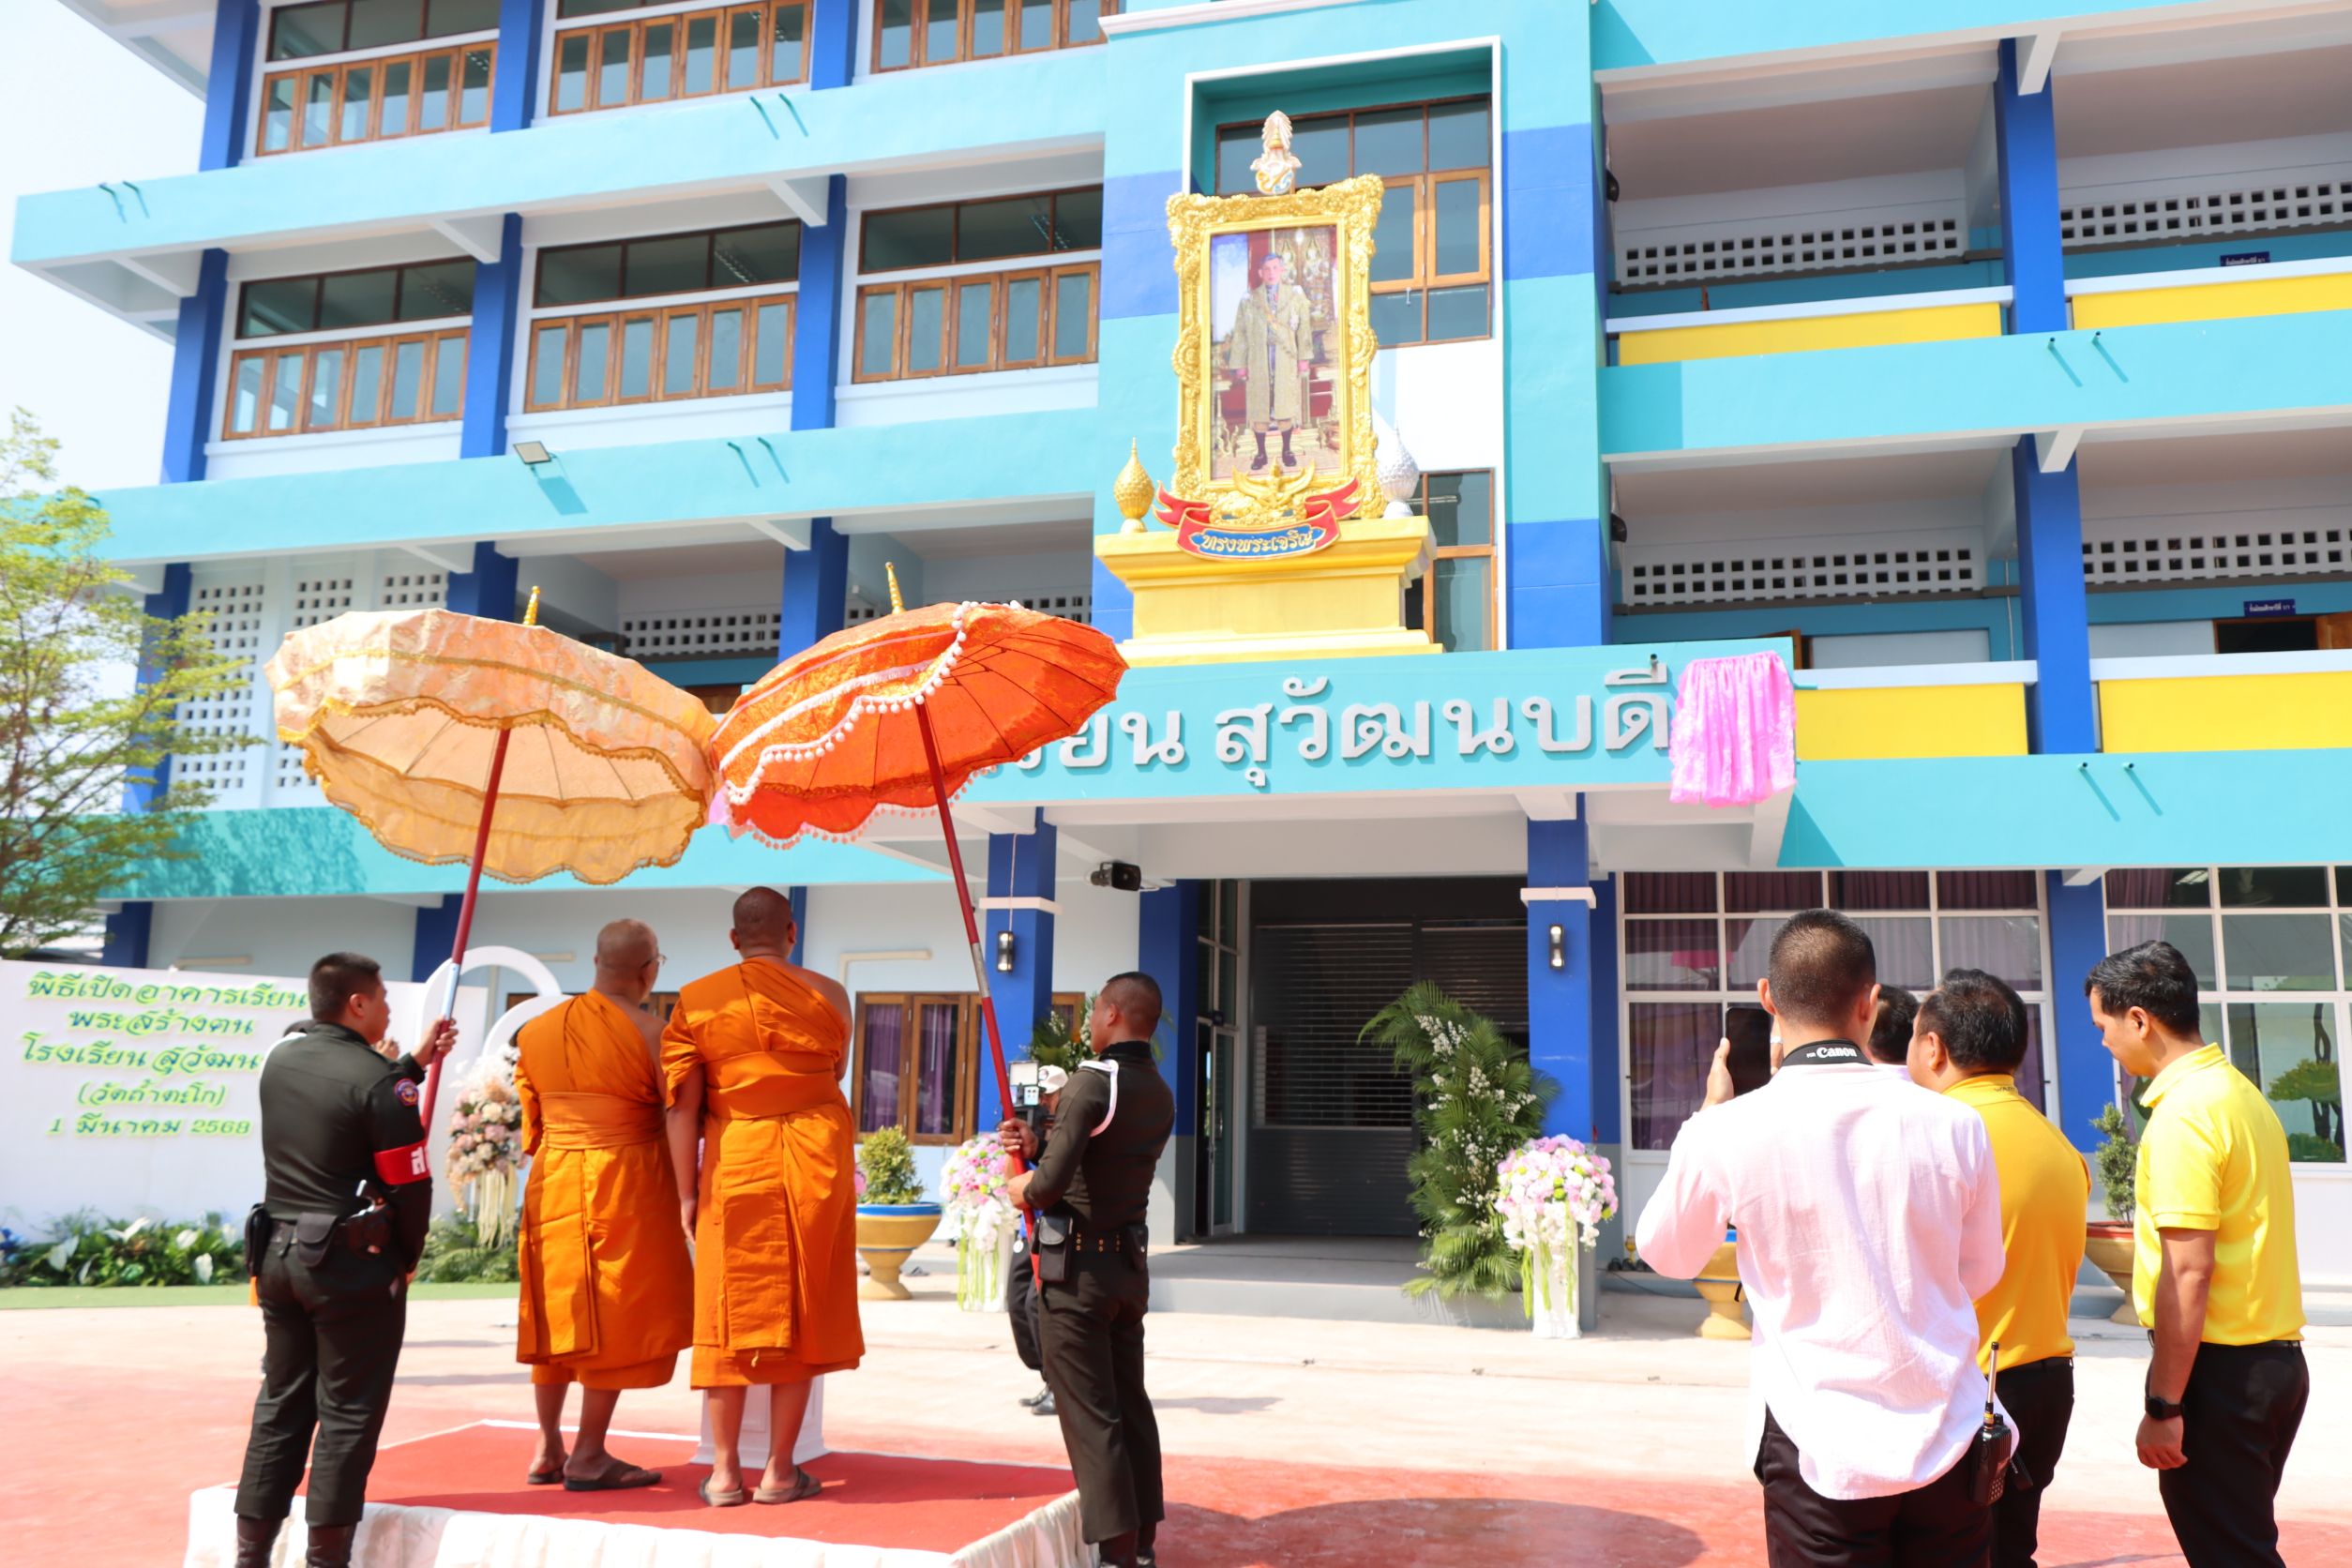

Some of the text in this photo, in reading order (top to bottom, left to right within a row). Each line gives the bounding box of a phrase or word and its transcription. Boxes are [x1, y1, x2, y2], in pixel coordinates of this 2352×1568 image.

[1214, 662, 1669, 786] สุวัฒนบดี
[1817, 1047, 1858, 1059] Canon
[76, 1112, 181, 1134] มีนาคม
[190, 1119, 250, 1134] 2568
